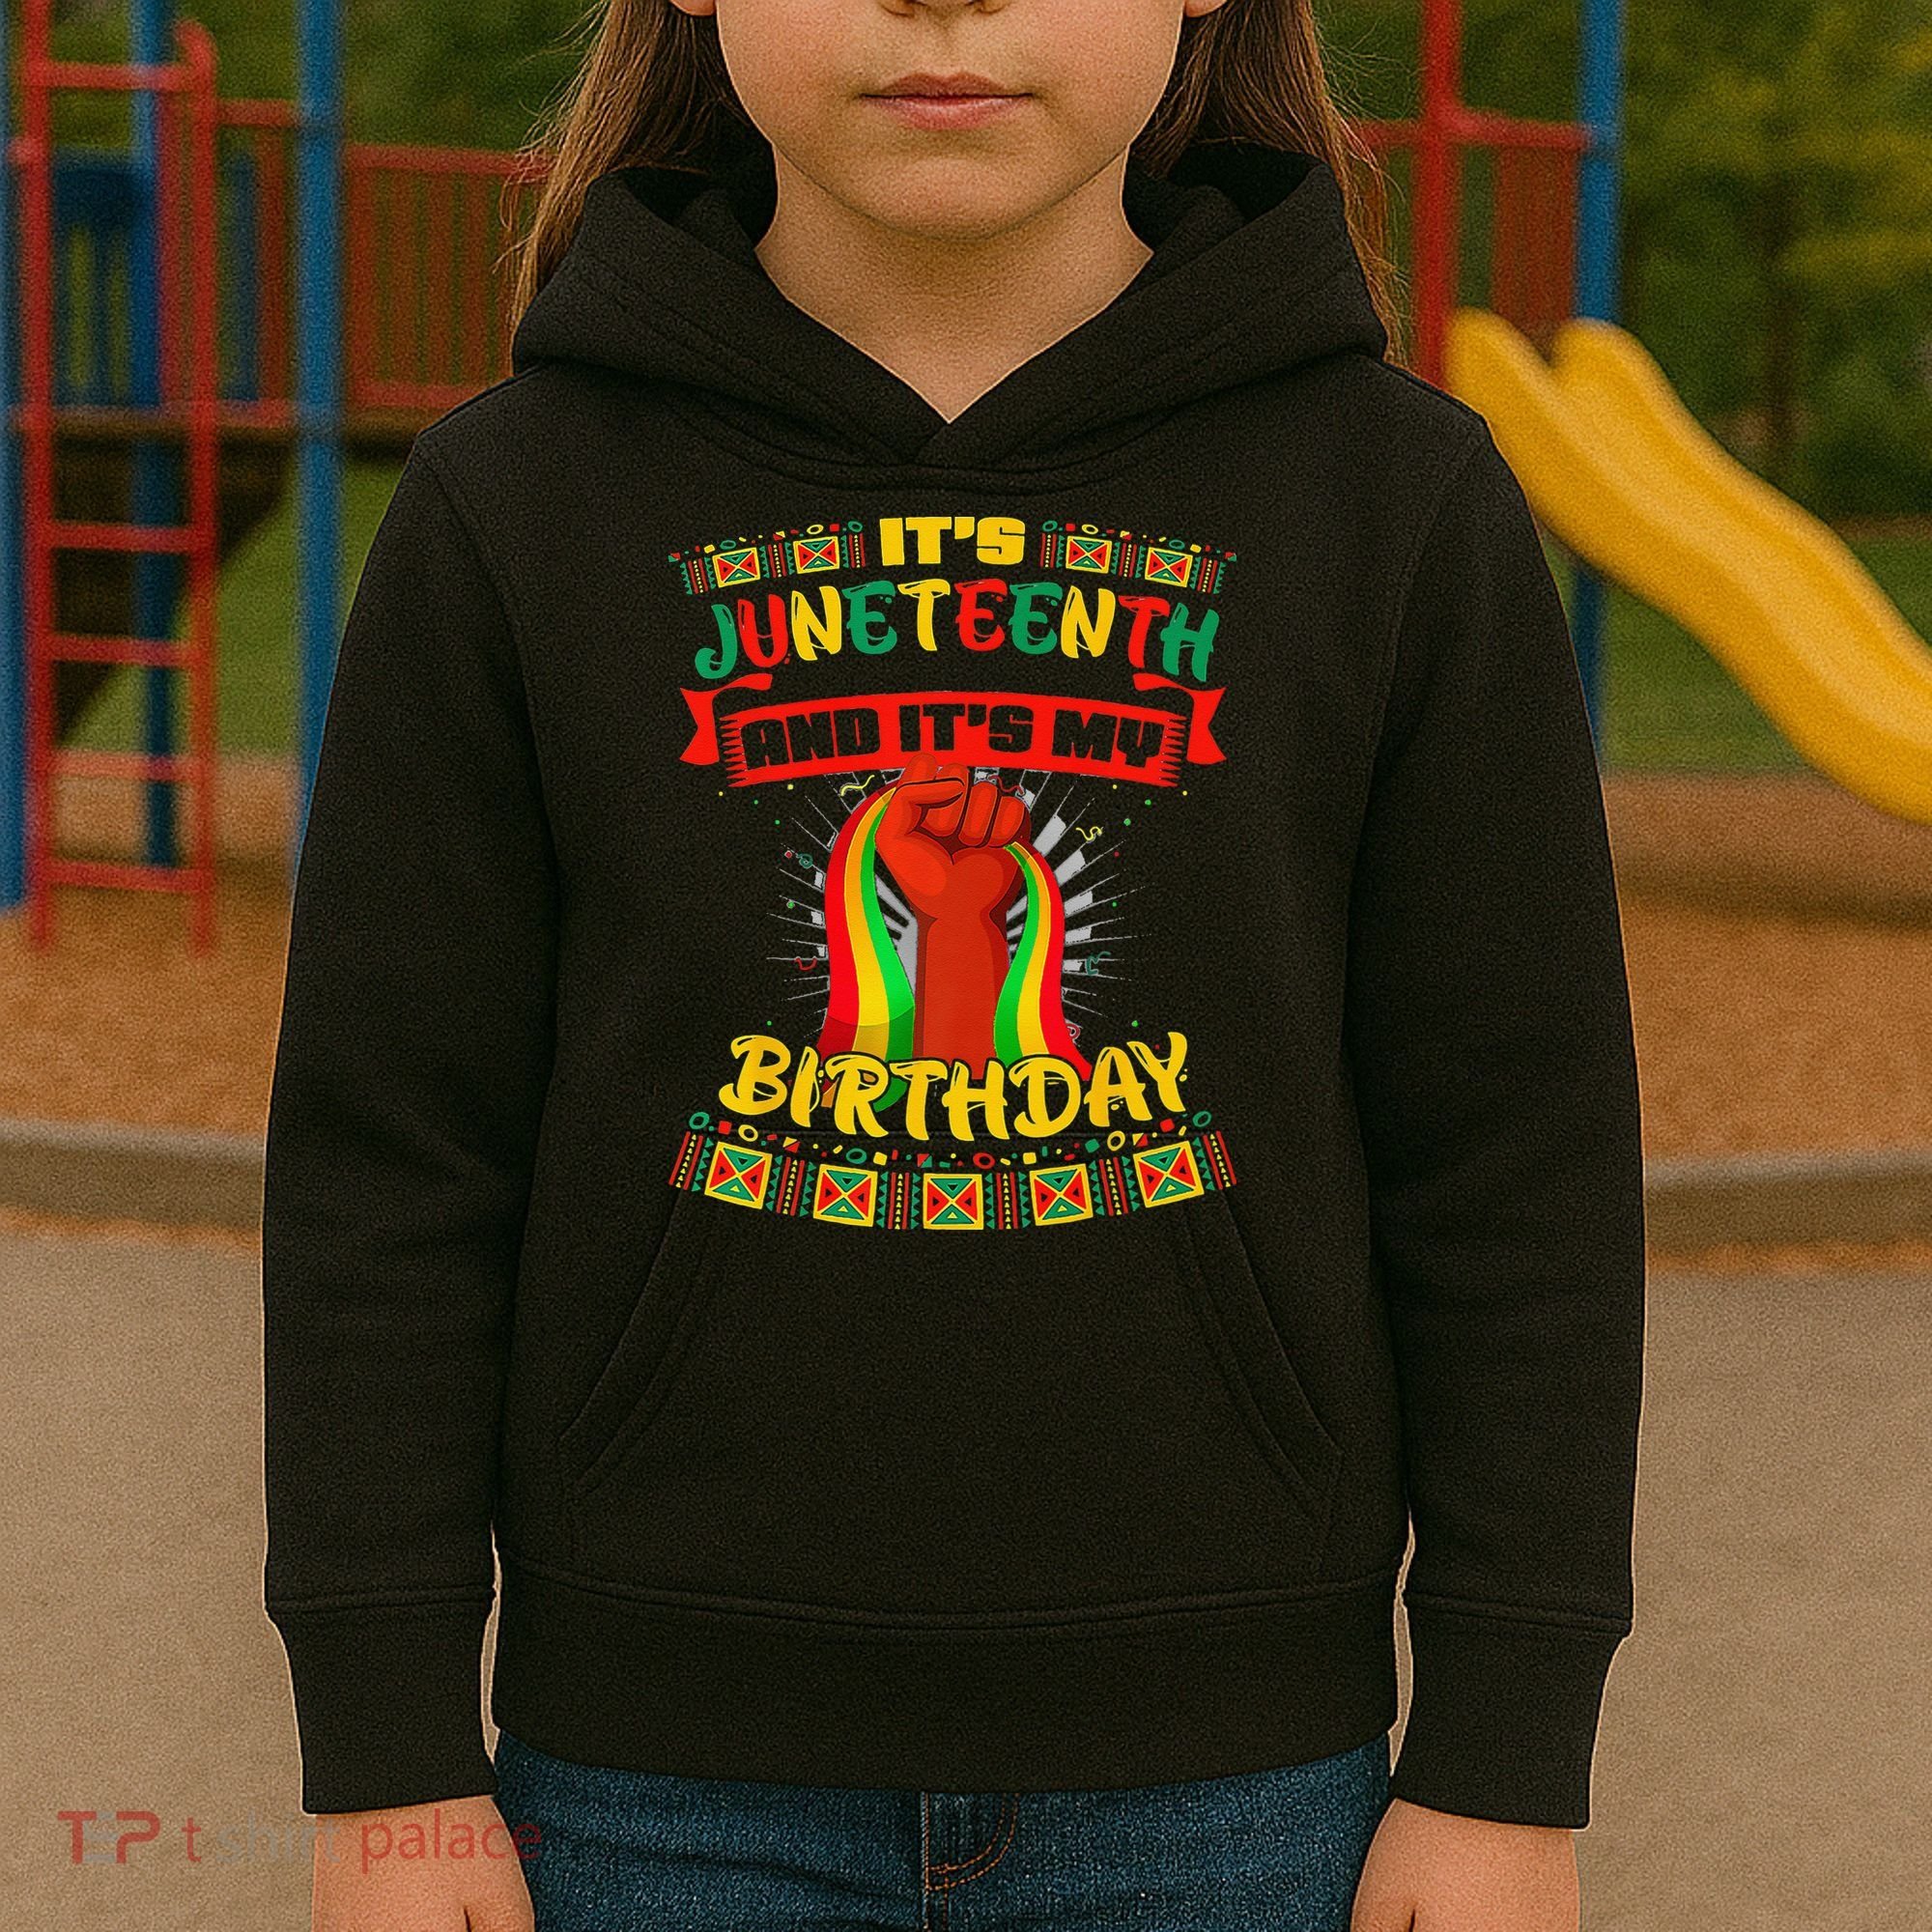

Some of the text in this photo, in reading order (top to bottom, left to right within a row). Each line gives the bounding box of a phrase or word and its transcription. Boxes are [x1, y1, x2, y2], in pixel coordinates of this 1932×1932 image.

[879, 516, 1026, 566] IT'S
[695, 579, 1220, 682] JUNETEENTH
[740, 703, 1165, 771] AND IT'S MY
[718, 1031, 1188, 1141] BIRTHDAY
